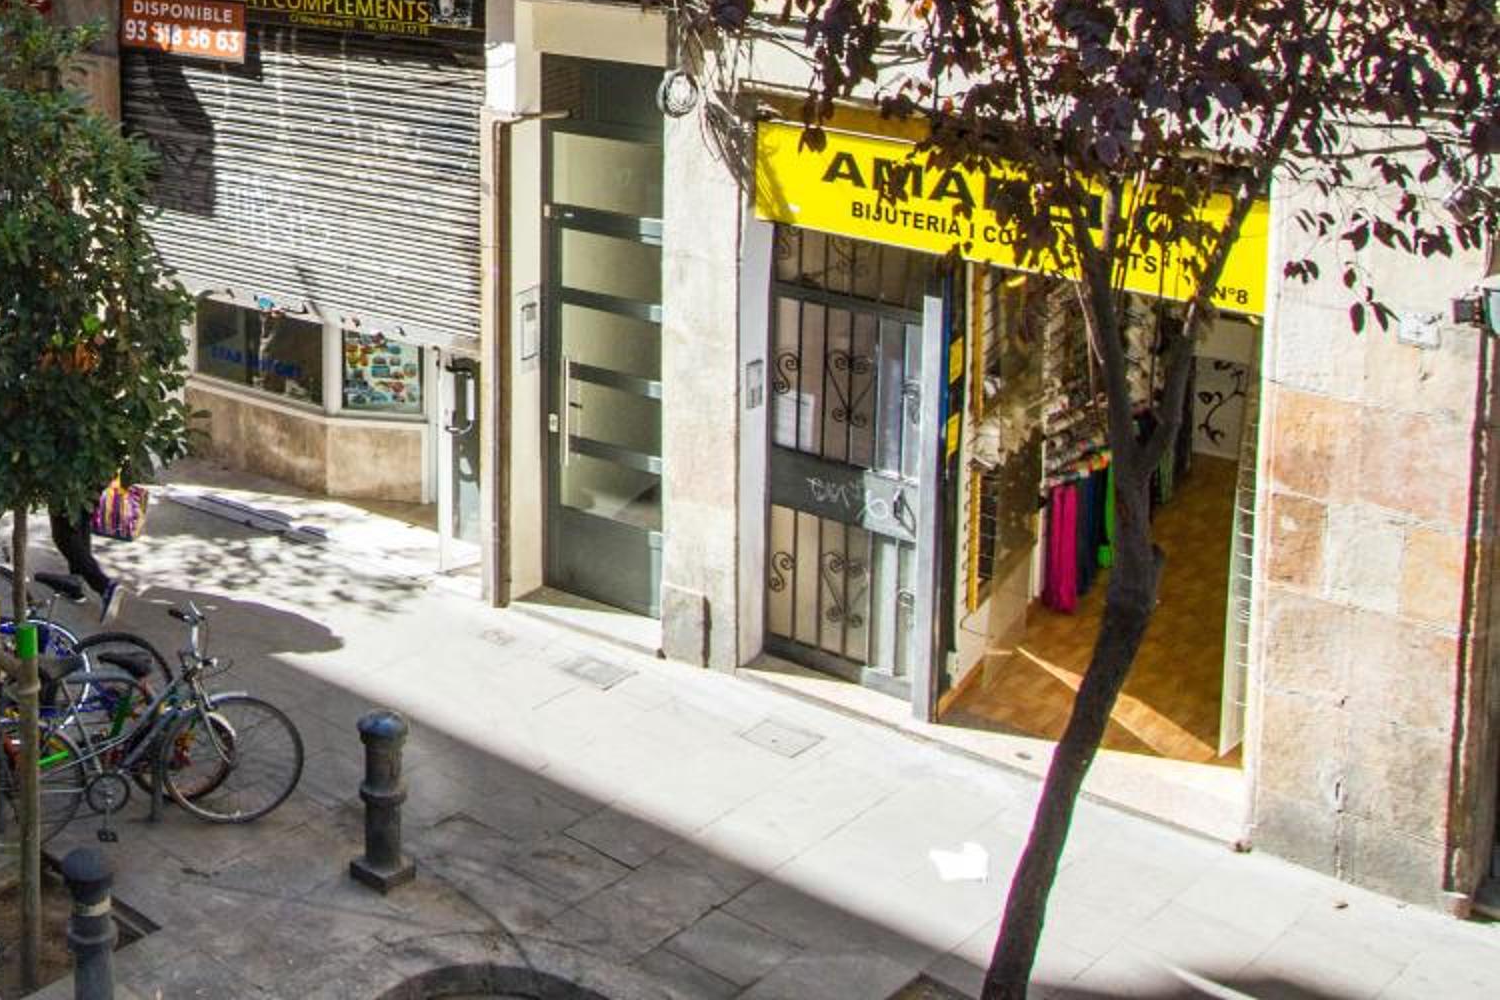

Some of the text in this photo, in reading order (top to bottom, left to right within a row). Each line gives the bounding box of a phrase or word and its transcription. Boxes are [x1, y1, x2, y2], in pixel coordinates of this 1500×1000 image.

[133, 0, 233, 23] DISPONIBLE
[125, 19, 147, 41] 93
[216, 29, 239, 52] 63
[852, 201, 960, 237] BIJUTERIA
